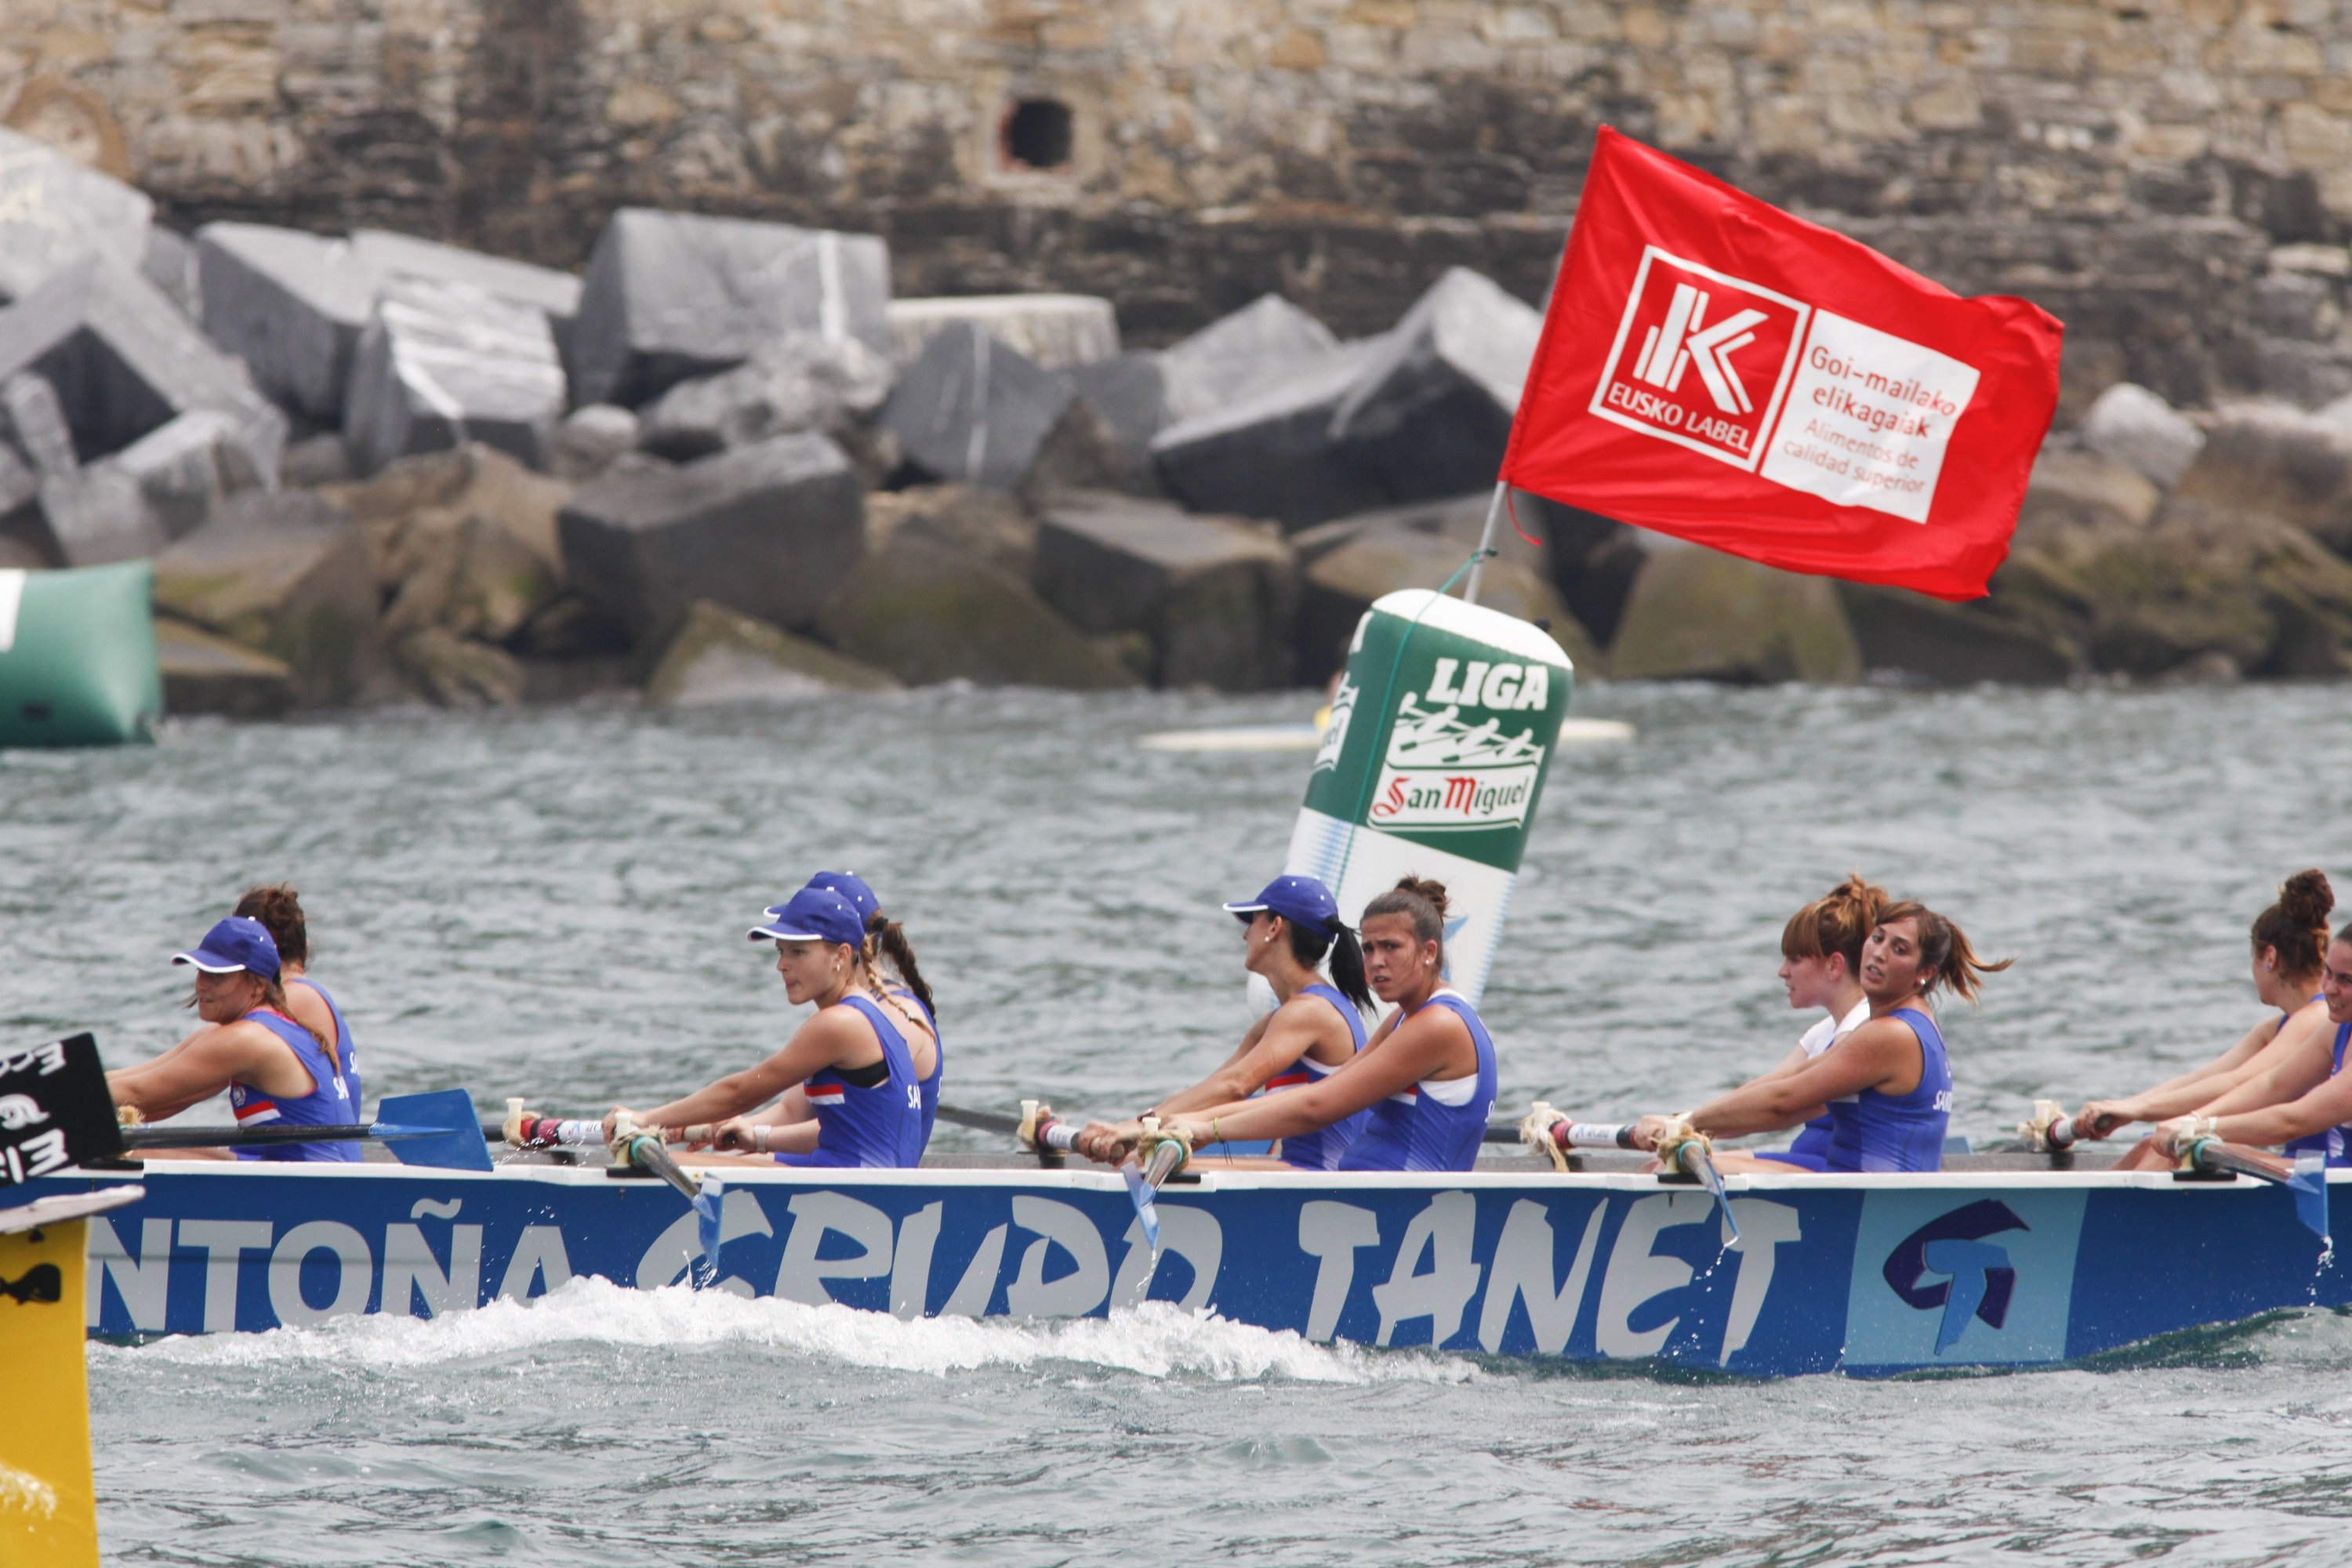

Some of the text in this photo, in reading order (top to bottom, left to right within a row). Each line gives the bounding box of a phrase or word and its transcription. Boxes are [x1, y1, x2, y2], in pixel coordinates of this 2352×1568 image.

[1810, 345, 1957, 417] Goi-mailako
[1607, 381, 1750, 453] EUSKO LABEL
[1813, 386, 1931, 438] elikagaiak
[1783, 440, 1926, 493] calidad superior
[1804, 418, 1919, 469] Alimentos de
[1425, 657, 1550, 711] LIGA
[1373, 776, 1530, 817] San Miguel
[1298, 1189, 1802, 1368] TANET
